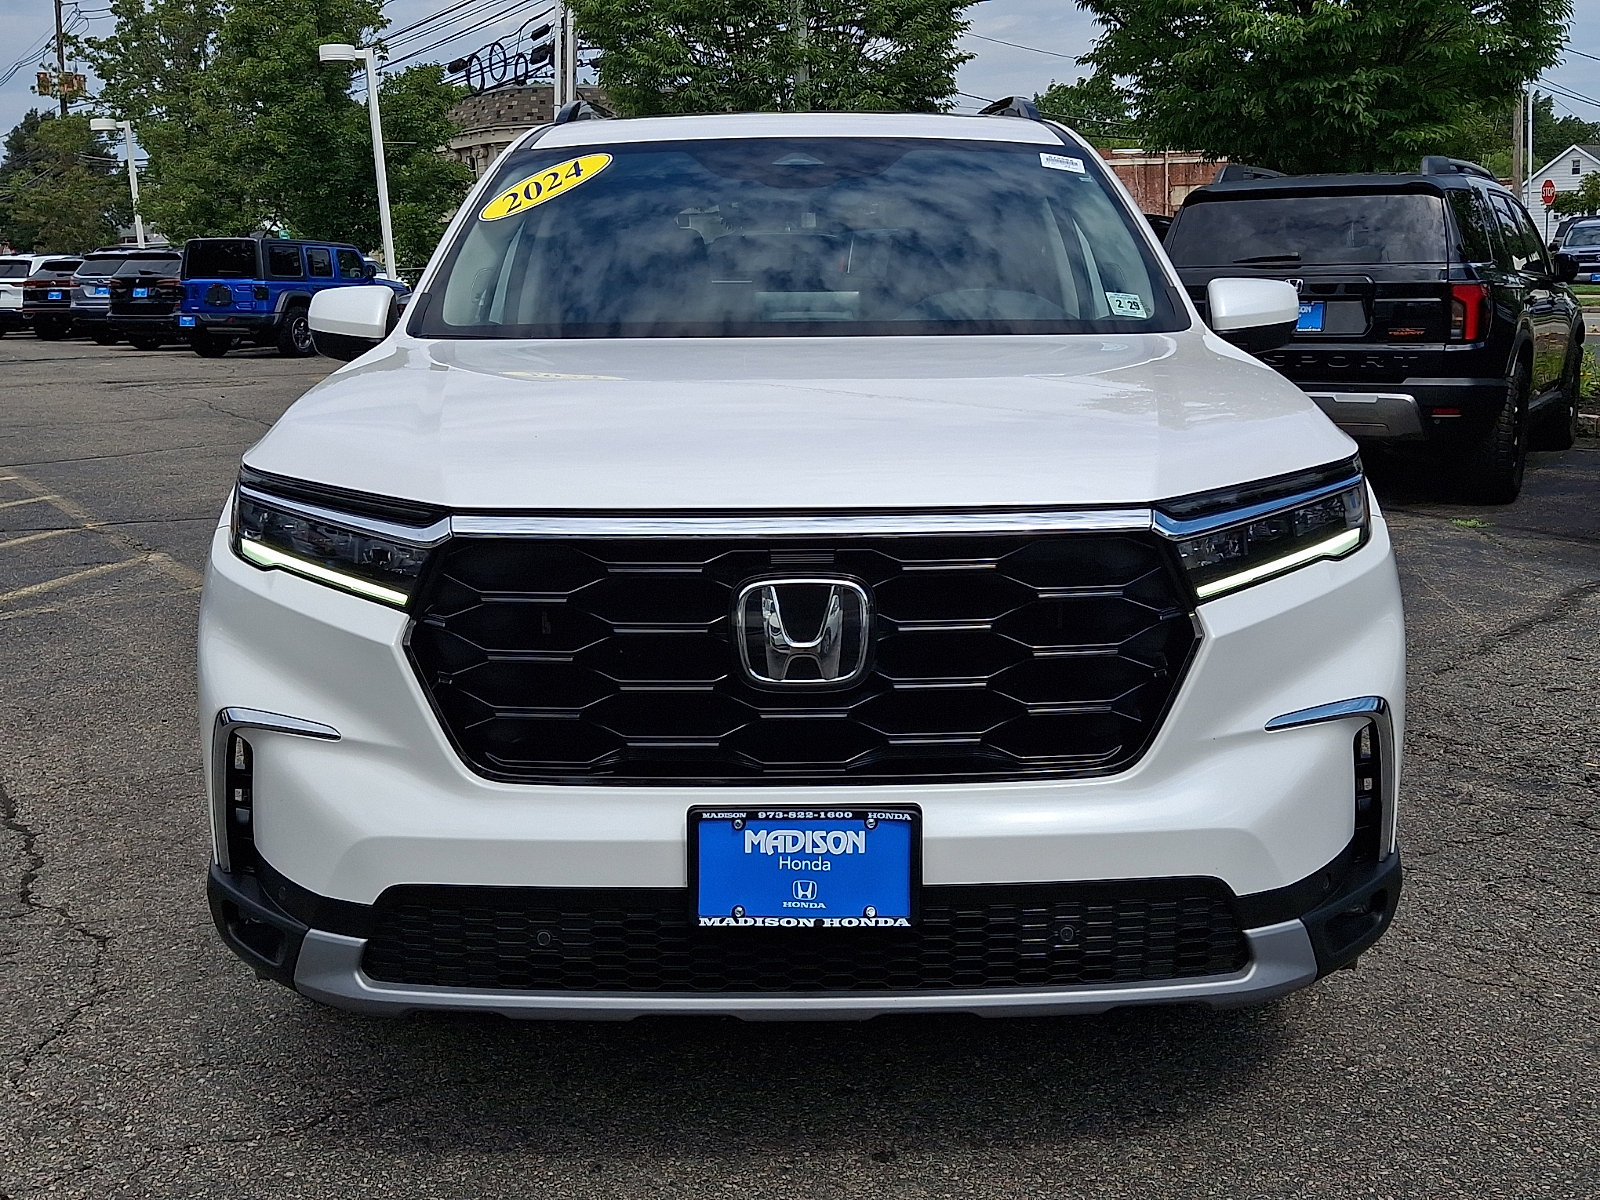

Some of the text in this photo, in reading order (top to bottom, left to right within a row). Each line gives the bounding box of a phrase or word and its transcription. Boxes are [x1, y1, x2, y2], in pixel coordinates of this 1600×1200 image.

[502, 160, 584, 214] 2024
[1542, 187, 1554, 197] STOP
[1116, 299, 1124, 308] 2
[1127, 301, 1140, 310] 29
[1263, 354, 1419, 368] SPORT
[757, 811, 853, 819] 973-822-1600
[867, 812, 912, 820] HONDA
[744, 829, 866, 855] MADISON
[778, 855, 832, 872] Honda
[782, 901, 827, 909] HONDA
[699, 917, 912, 927] MADISON HONDA
